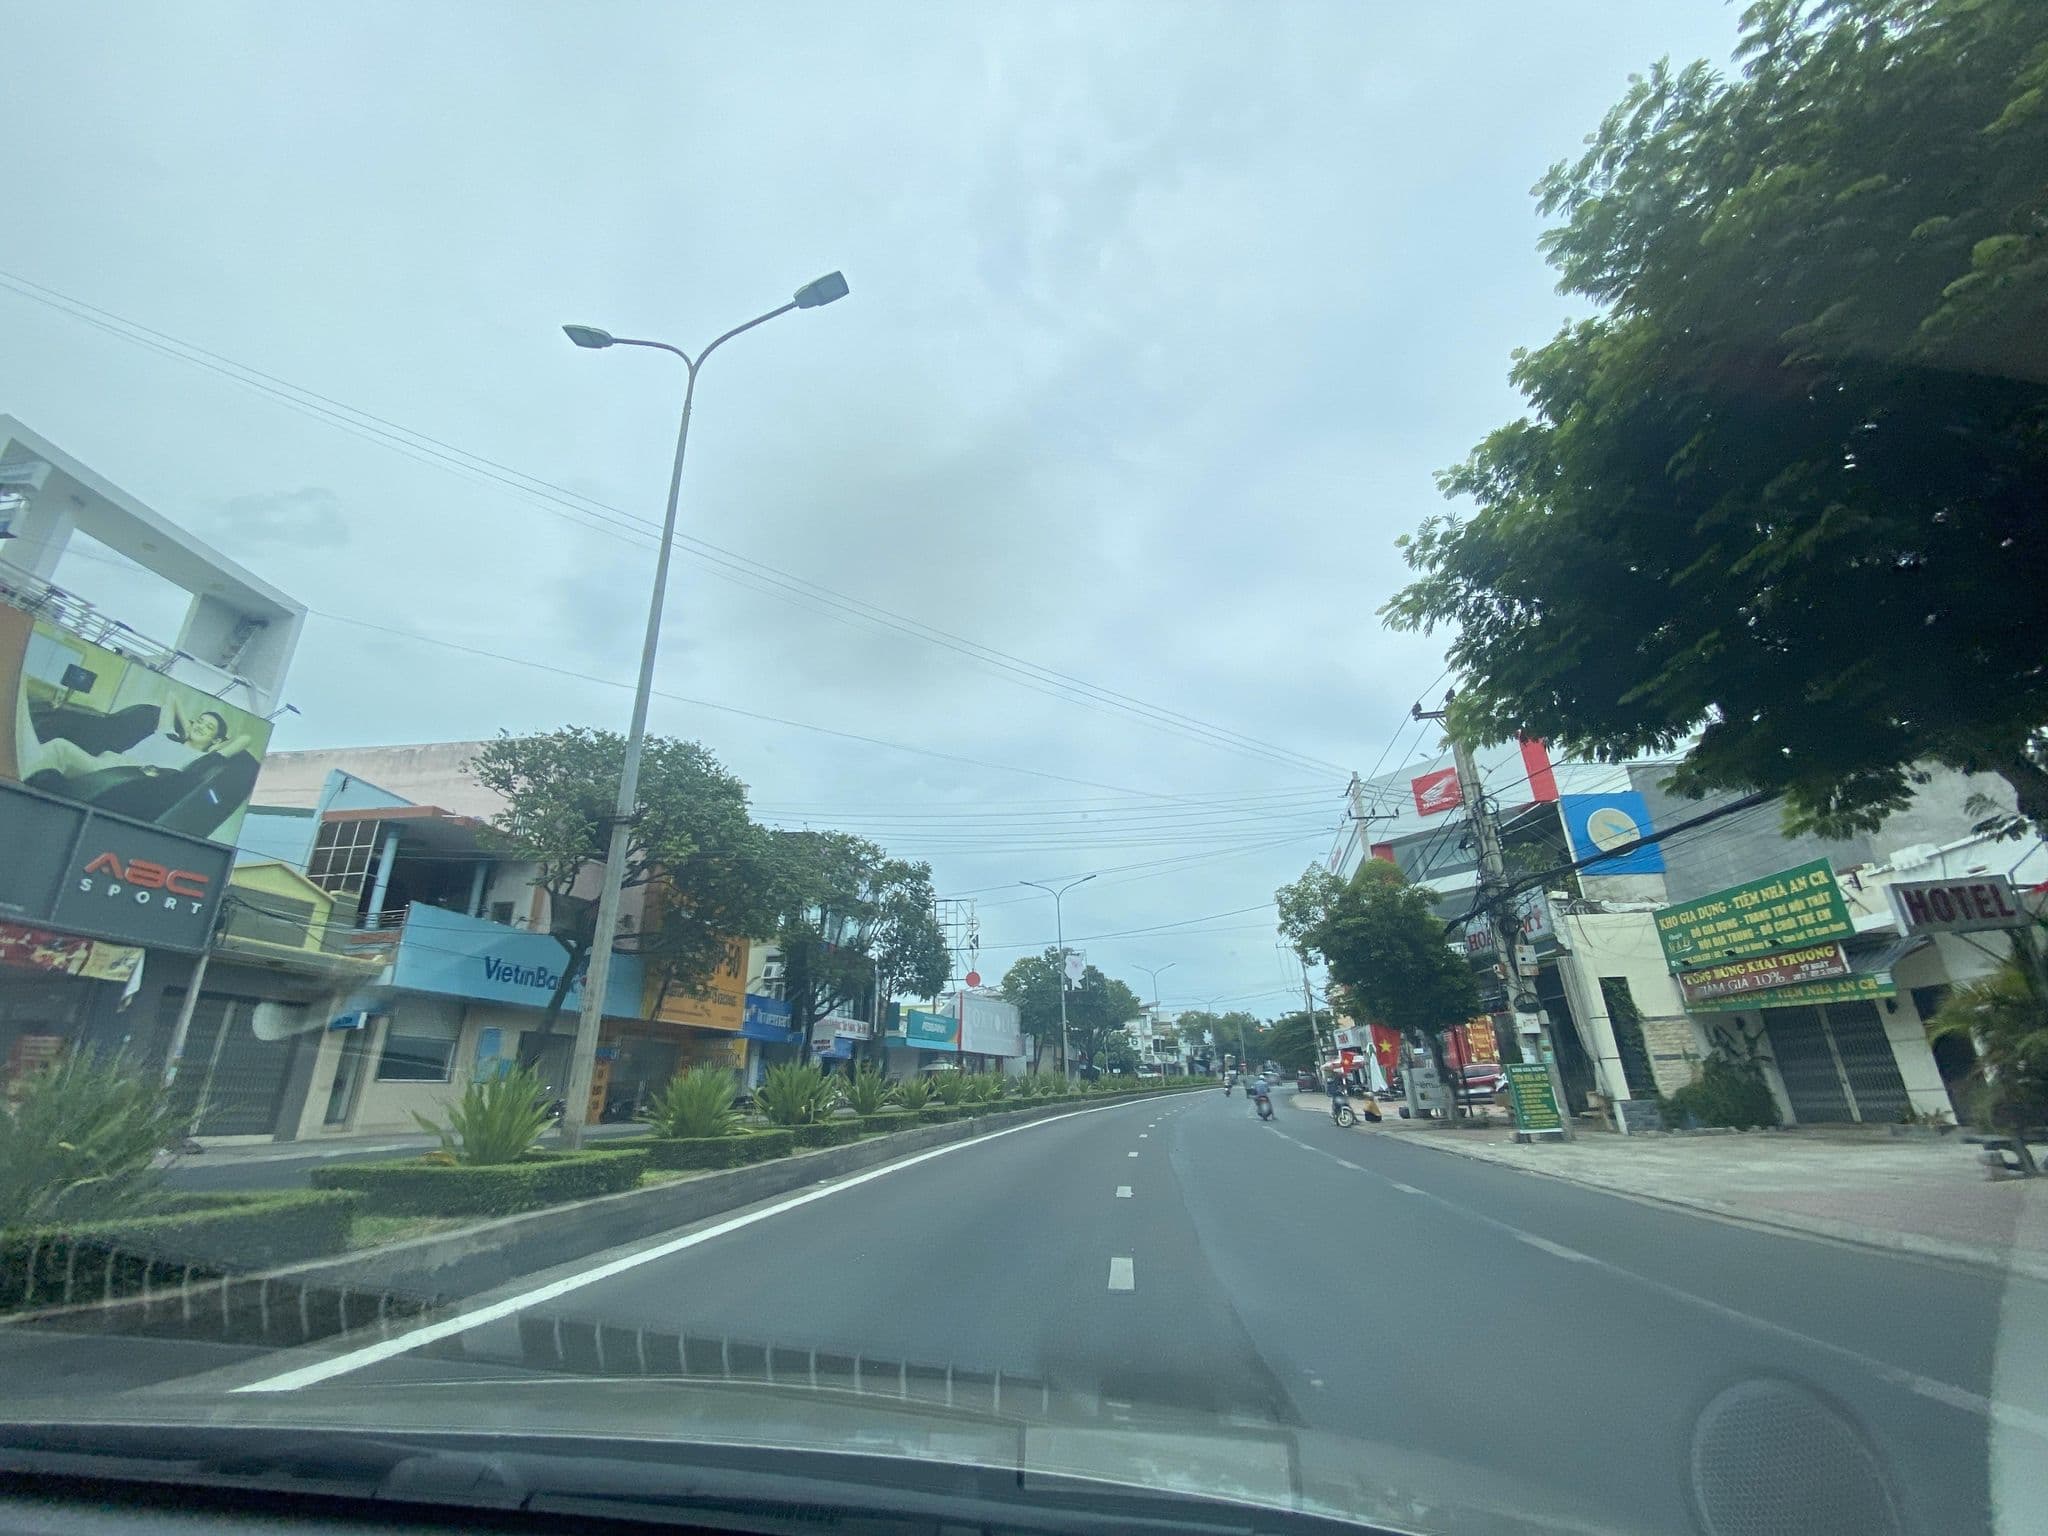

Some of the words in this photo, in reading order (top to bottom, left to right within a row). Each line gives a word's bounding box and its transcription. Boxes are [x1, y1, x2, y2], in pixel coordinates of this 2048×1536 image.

[83, 852, 209, 898] ABC
[79, 878, 203, 915] SPORT
[1659, 915, 1679, 930] KHO
[1680, 910, 1697, 924] GIA
[1697, 902, 1727, 920] DỤNG
[1732, 890, 1760, 909] TIỆM
[1760, 880, 1788, 901] NHÀ
[1789, 876, 1808, 893] AN
[1901, 883, 2017, 926] HOTEL
[1727, 974, 1750, 992] GIÁ
[1753, 970, 1785, 986] 10%
[1746, 957, 1778, 973] KHAI
